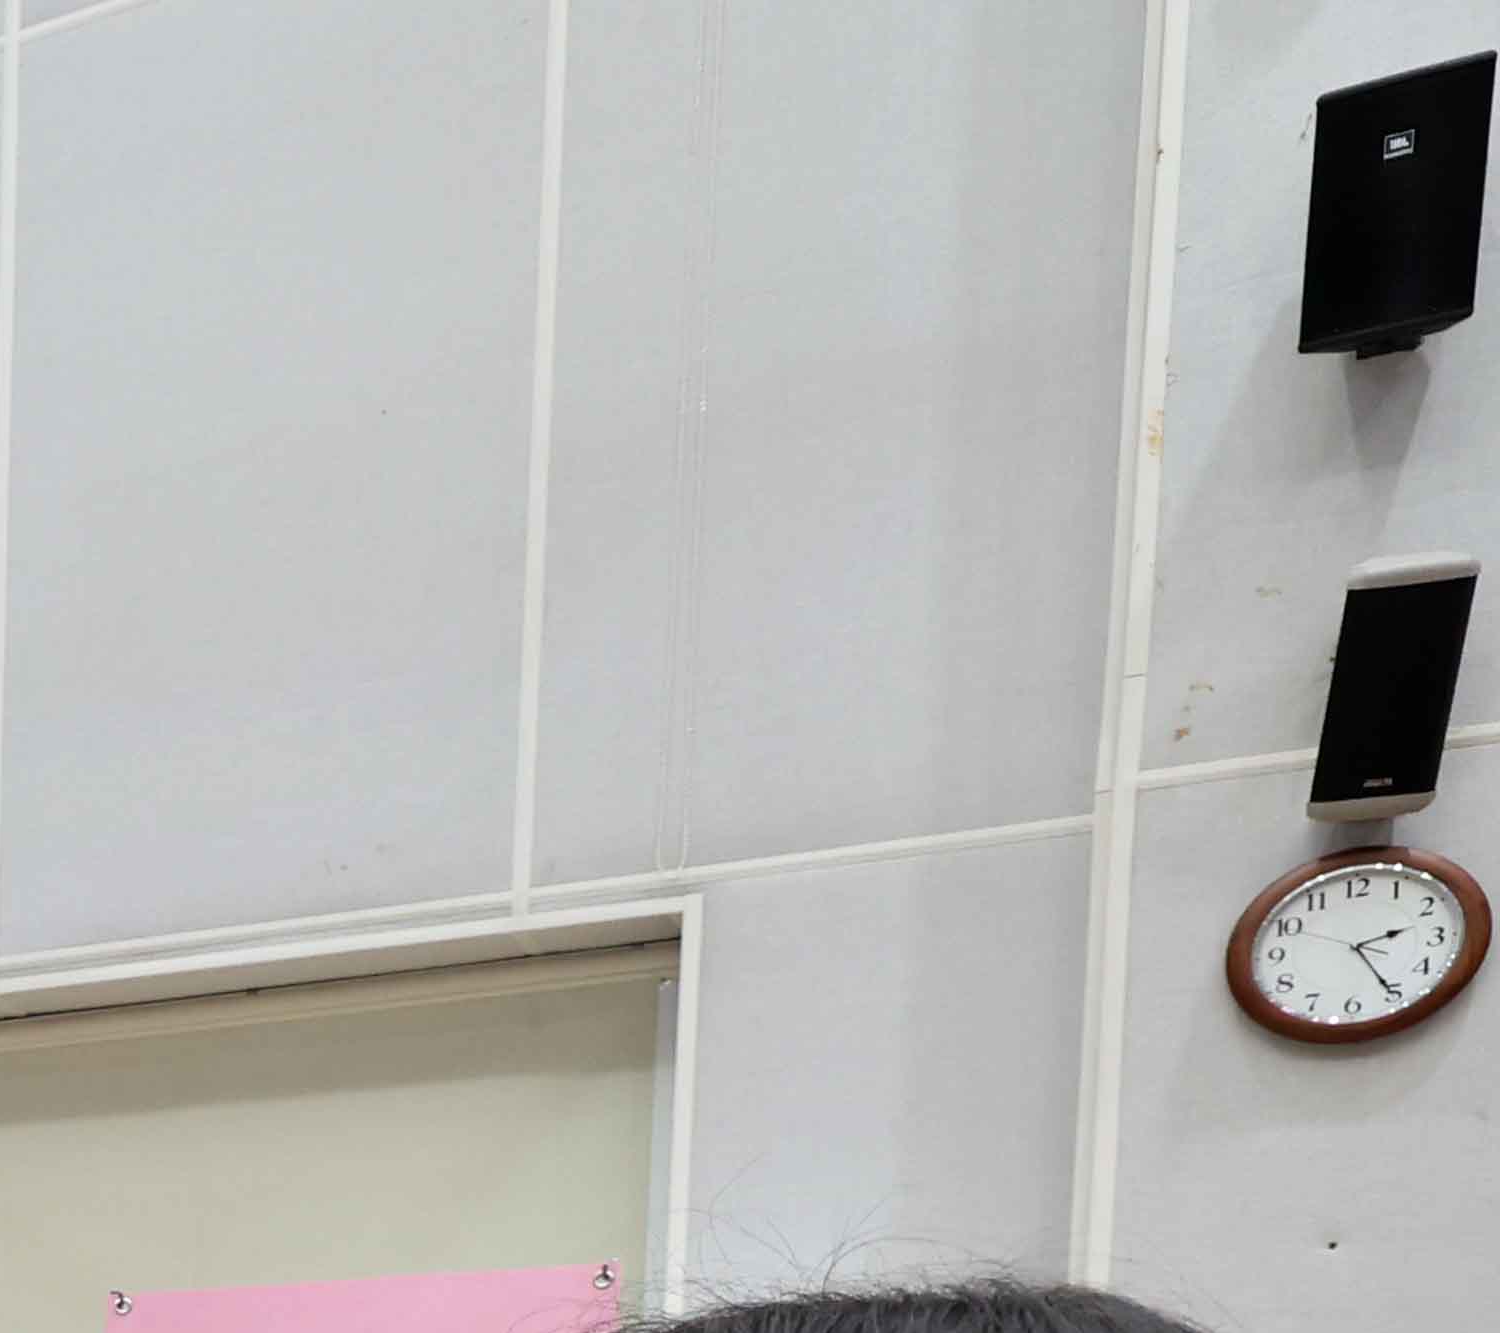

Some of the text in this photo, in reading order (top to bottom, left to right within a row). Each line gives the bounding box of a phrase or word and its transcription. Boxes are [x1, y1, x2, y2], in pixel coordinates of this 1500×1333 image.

[1345, 877, 1371, 900] 12
[1391, 879, 1401, 900] 1
[1306, 892, 1327, 912] 11
[1418, 896, 1435, 917] 2
[1276, 917, 1303, 937] 10
[1426, 926, 1446, 948] 3
[1267, 946, 1286, 967] 9
[1411, 956, 1431, 976] 4
[1275, 973, 1295, 993] 8
[1304, 993, 1322, 1012] 7
[1343, 997, 1362, 1015] 6
